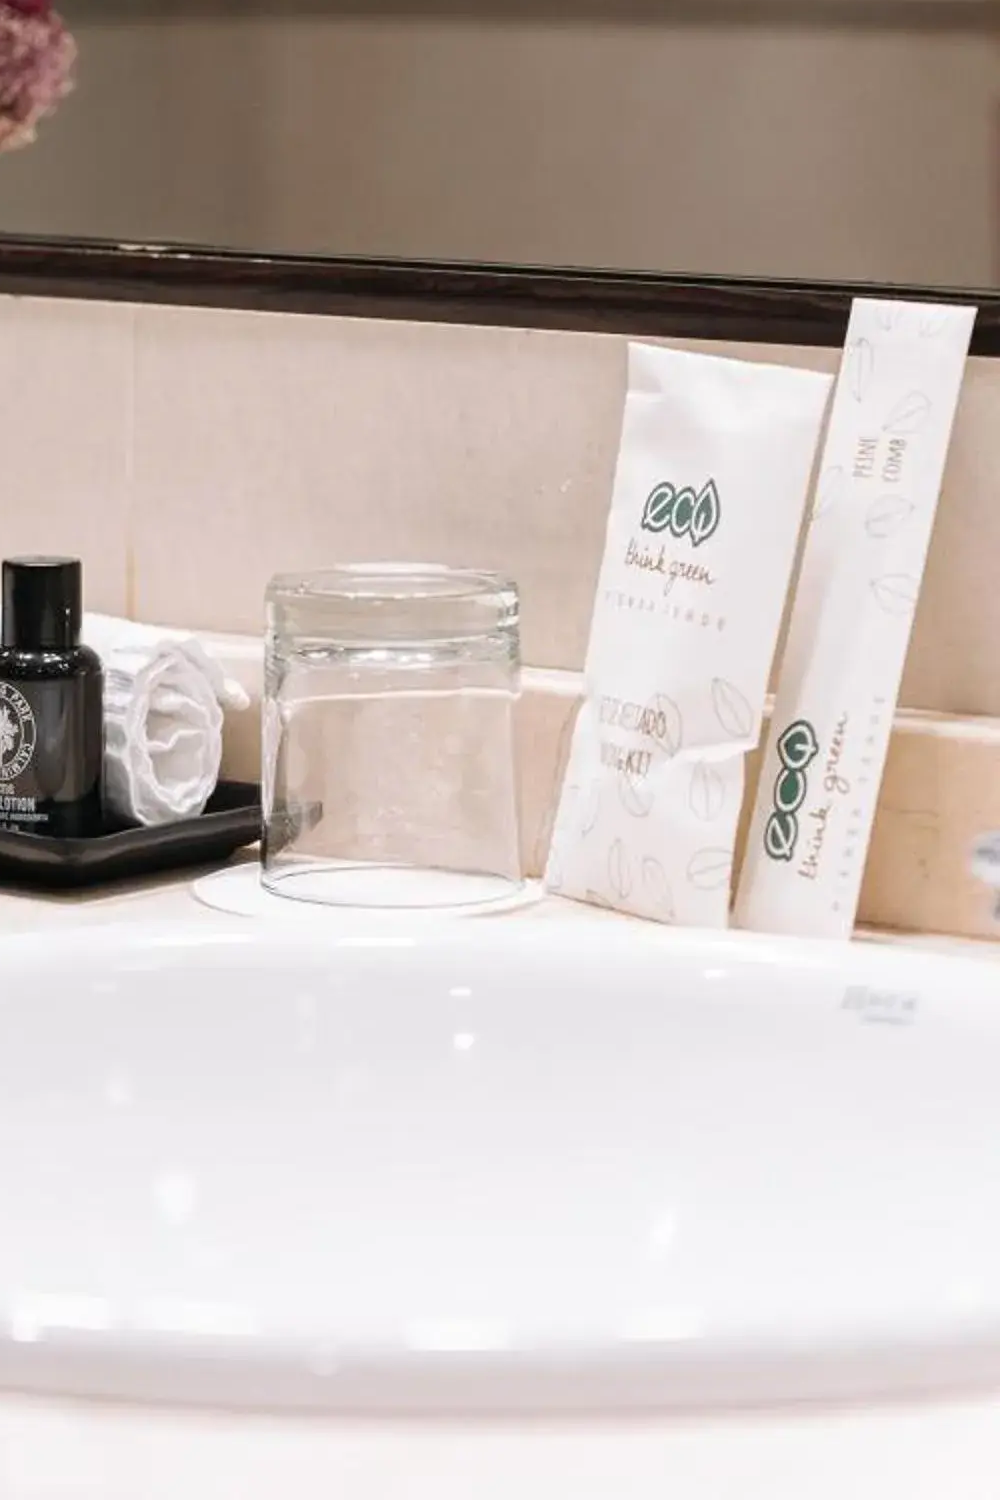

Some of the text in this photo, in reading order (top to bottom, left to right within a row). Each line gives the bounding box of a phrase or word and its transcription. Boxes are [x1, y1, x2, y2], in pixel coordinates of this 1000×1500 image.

[640, 477, 721, 548] eco
[624, 536, 717, 597] think green
[0, 796, 36, 813] LOTION
[764, 719, 820, 863] eco
[797, 710, 851, 881] think green
